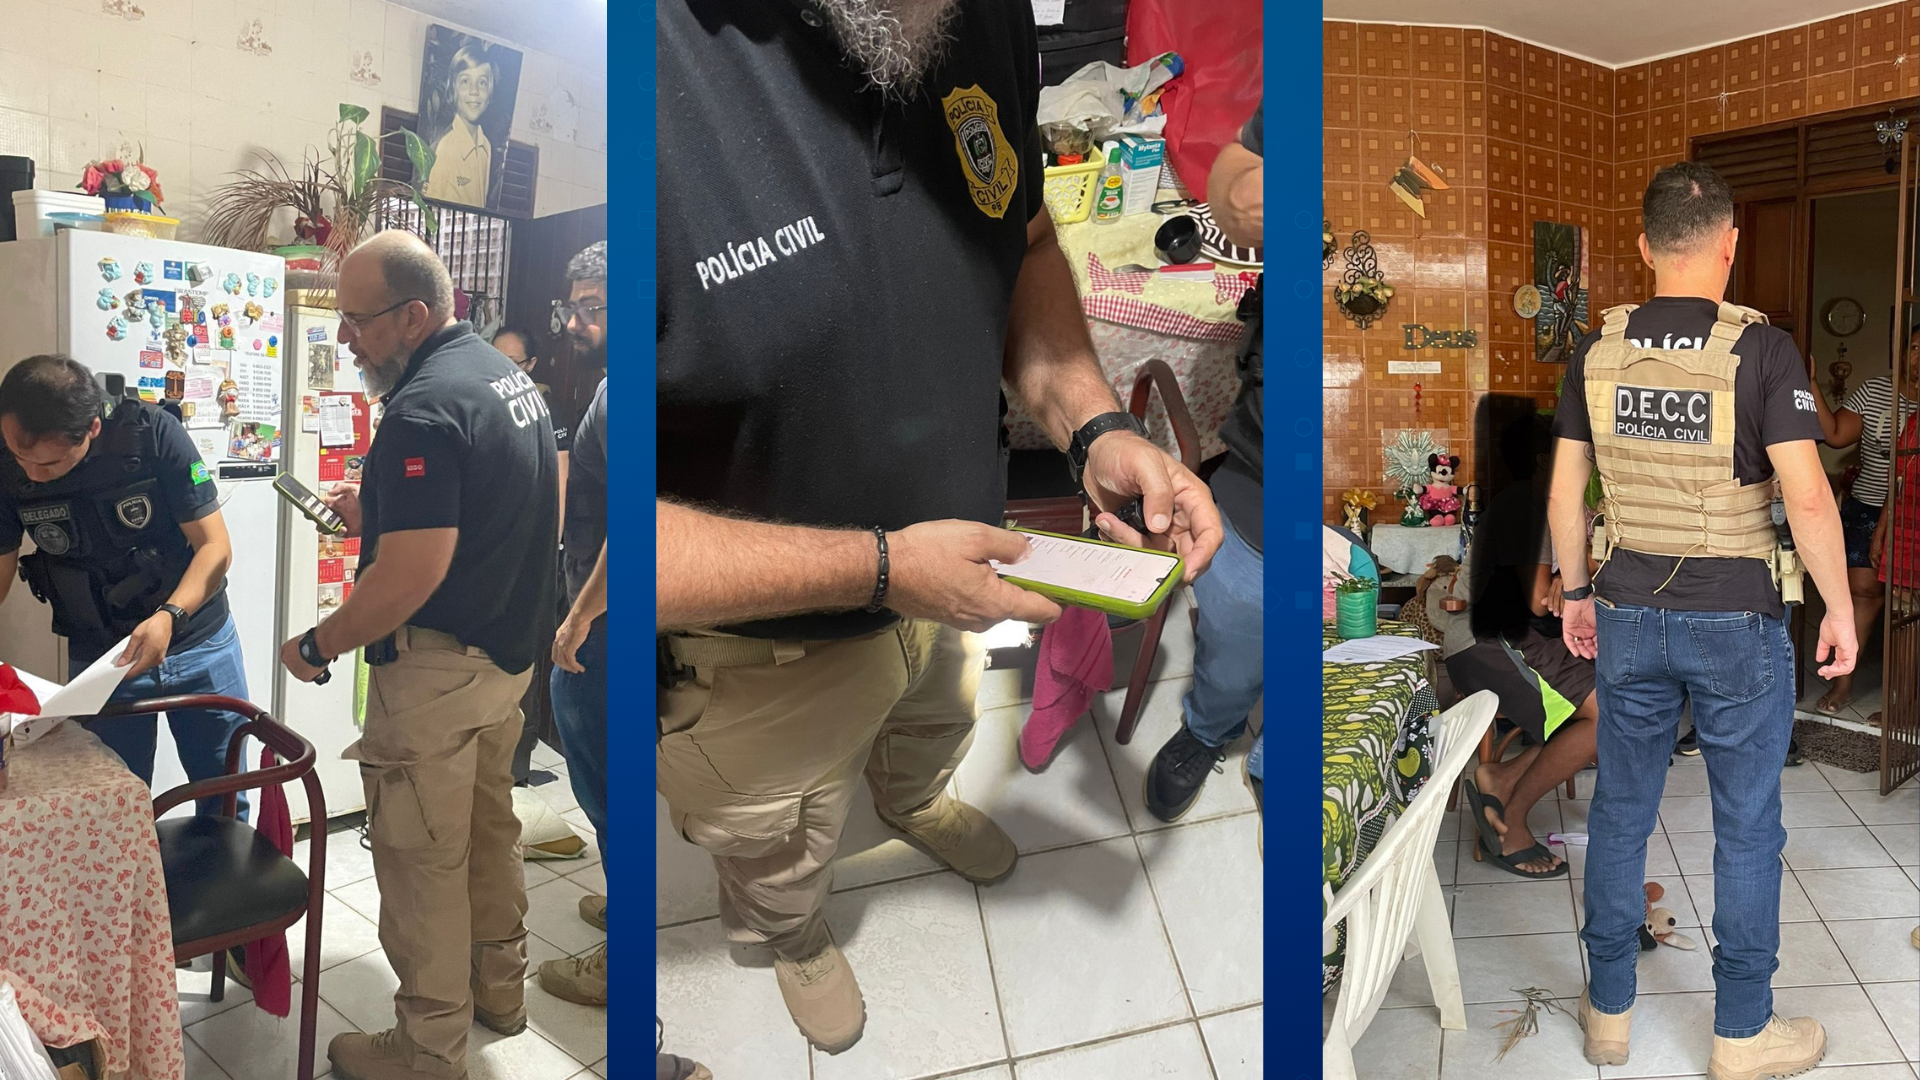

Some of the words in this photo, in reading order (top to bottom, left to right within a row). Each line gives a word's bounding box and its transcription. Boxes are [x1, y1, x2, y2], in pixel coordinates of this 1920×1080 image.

[976, 180, 1009, 203] CIVIL
[991, 202, 1002, 213] PB
[695, 237, 778, 291] POLÍCIA
[775, 216, 825, 256] CIVIL
[1402, 323, 1478, 350] Deus
[489, 370, 537, 399] POLÍCI
[1617, 388, 1707, 424] D.E.C.C
[1616, 420, 1667, 439] POLÍCIA
[1674, 427, 1708, 442] CIVIL
[22, 507, 67, 522] DELEGADO
